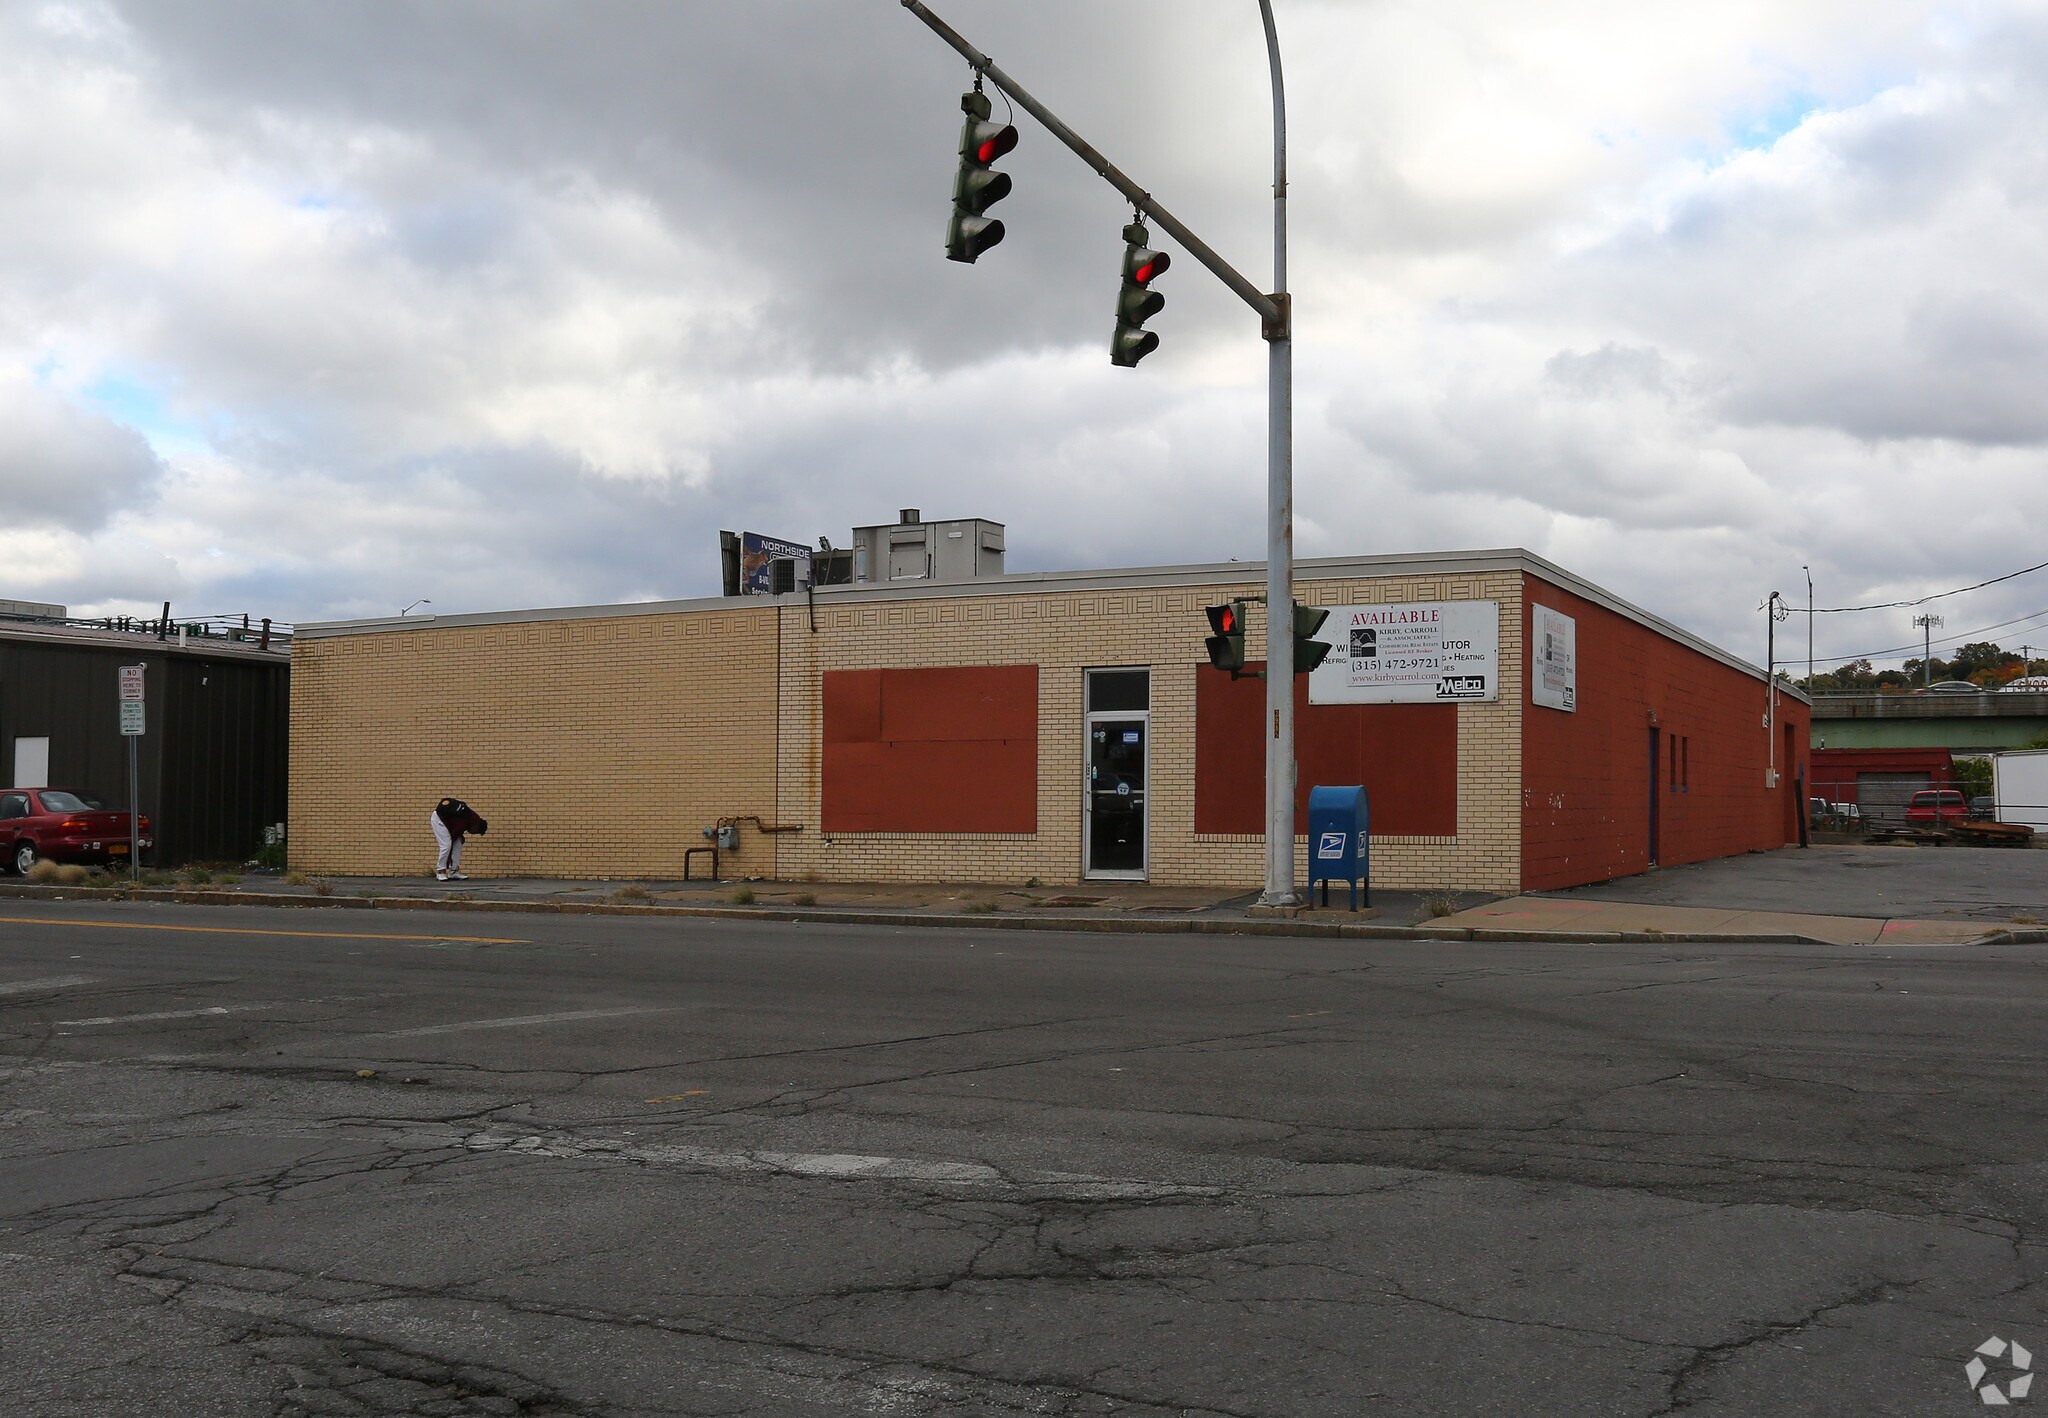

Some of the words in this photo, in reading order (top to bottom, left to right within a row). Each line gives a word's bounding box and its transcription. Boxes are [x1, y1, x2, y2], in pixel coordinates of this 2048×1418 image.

[761, 540, 810, 559] NORTHSIDE
[1350, 610, 1440, 626] AVAILABLE
[1404, 626, 1439, 634] CARROLL
[1352, 660, 1381, 672] (315)
[1385, 658, 1439, 669] 472-9721
[1352, 672, 1440, 682] www.kirbycarrol.com
[1439, 676, 1482, 693] Melco
